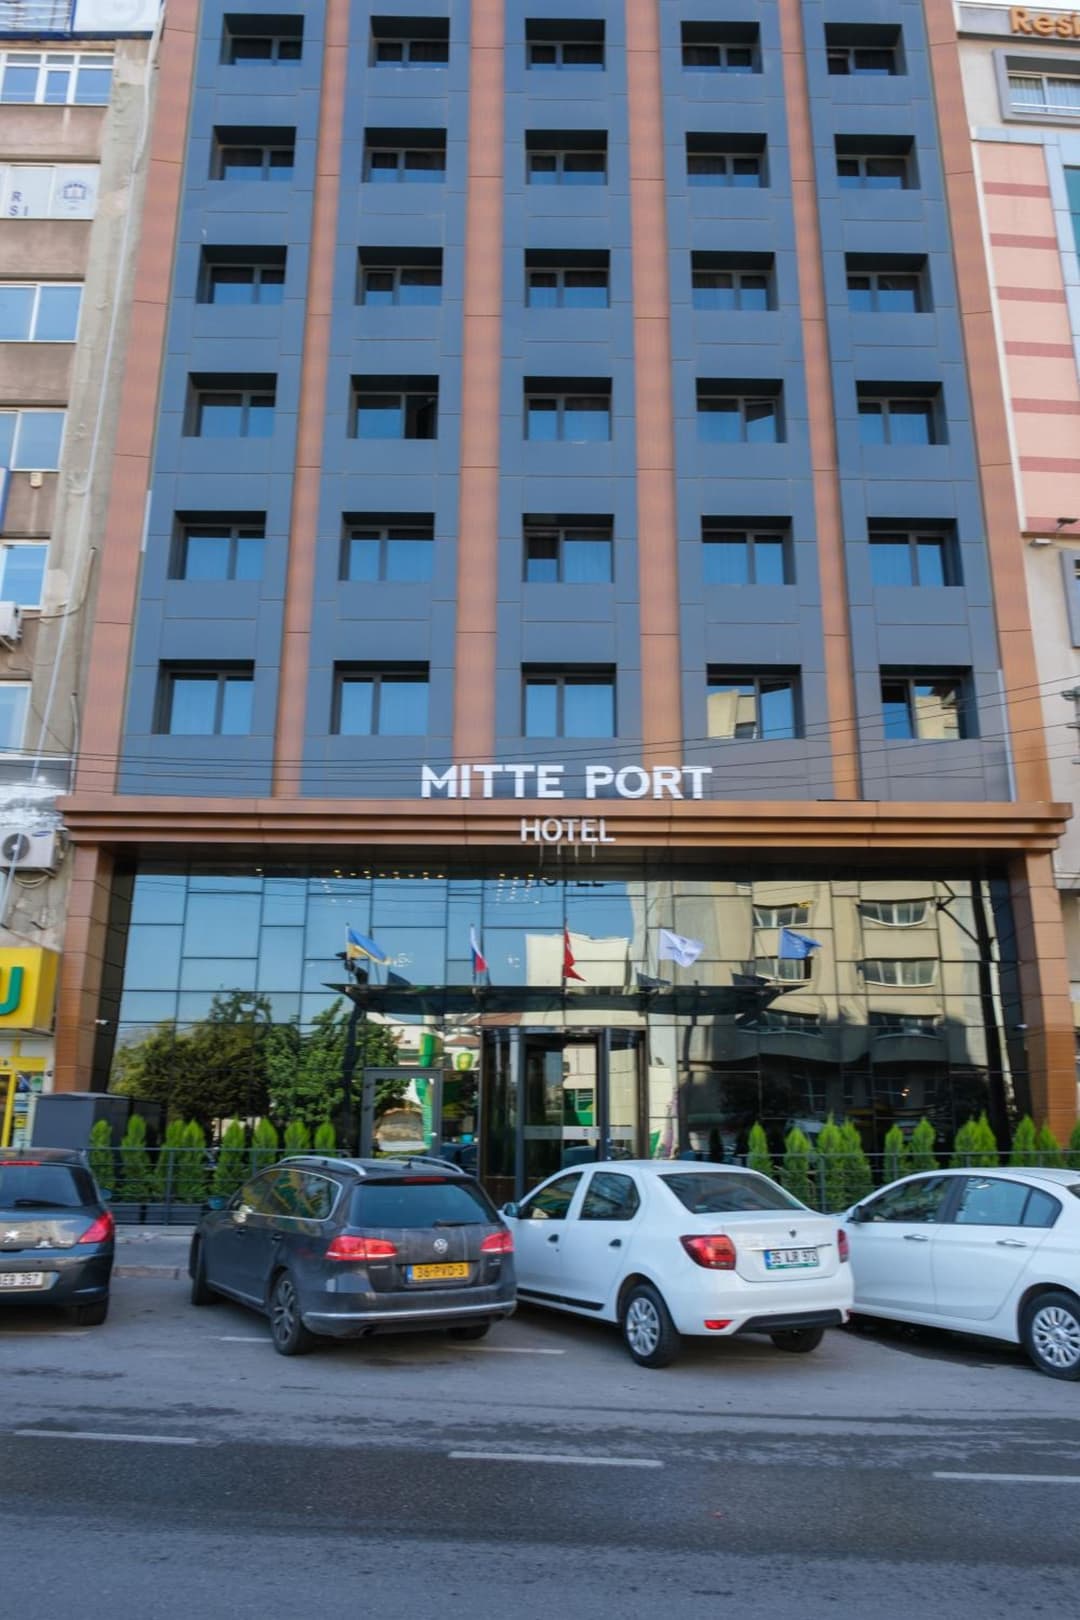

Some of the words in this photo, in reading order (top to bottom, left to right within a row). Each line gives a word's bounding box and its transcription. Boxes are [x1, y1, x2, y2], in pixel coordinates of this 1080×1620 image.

[421, 764, 564, 799] MITTE
[586, 765, 713, 799] PORT
[520, 818, 616, 843] HOTEL
